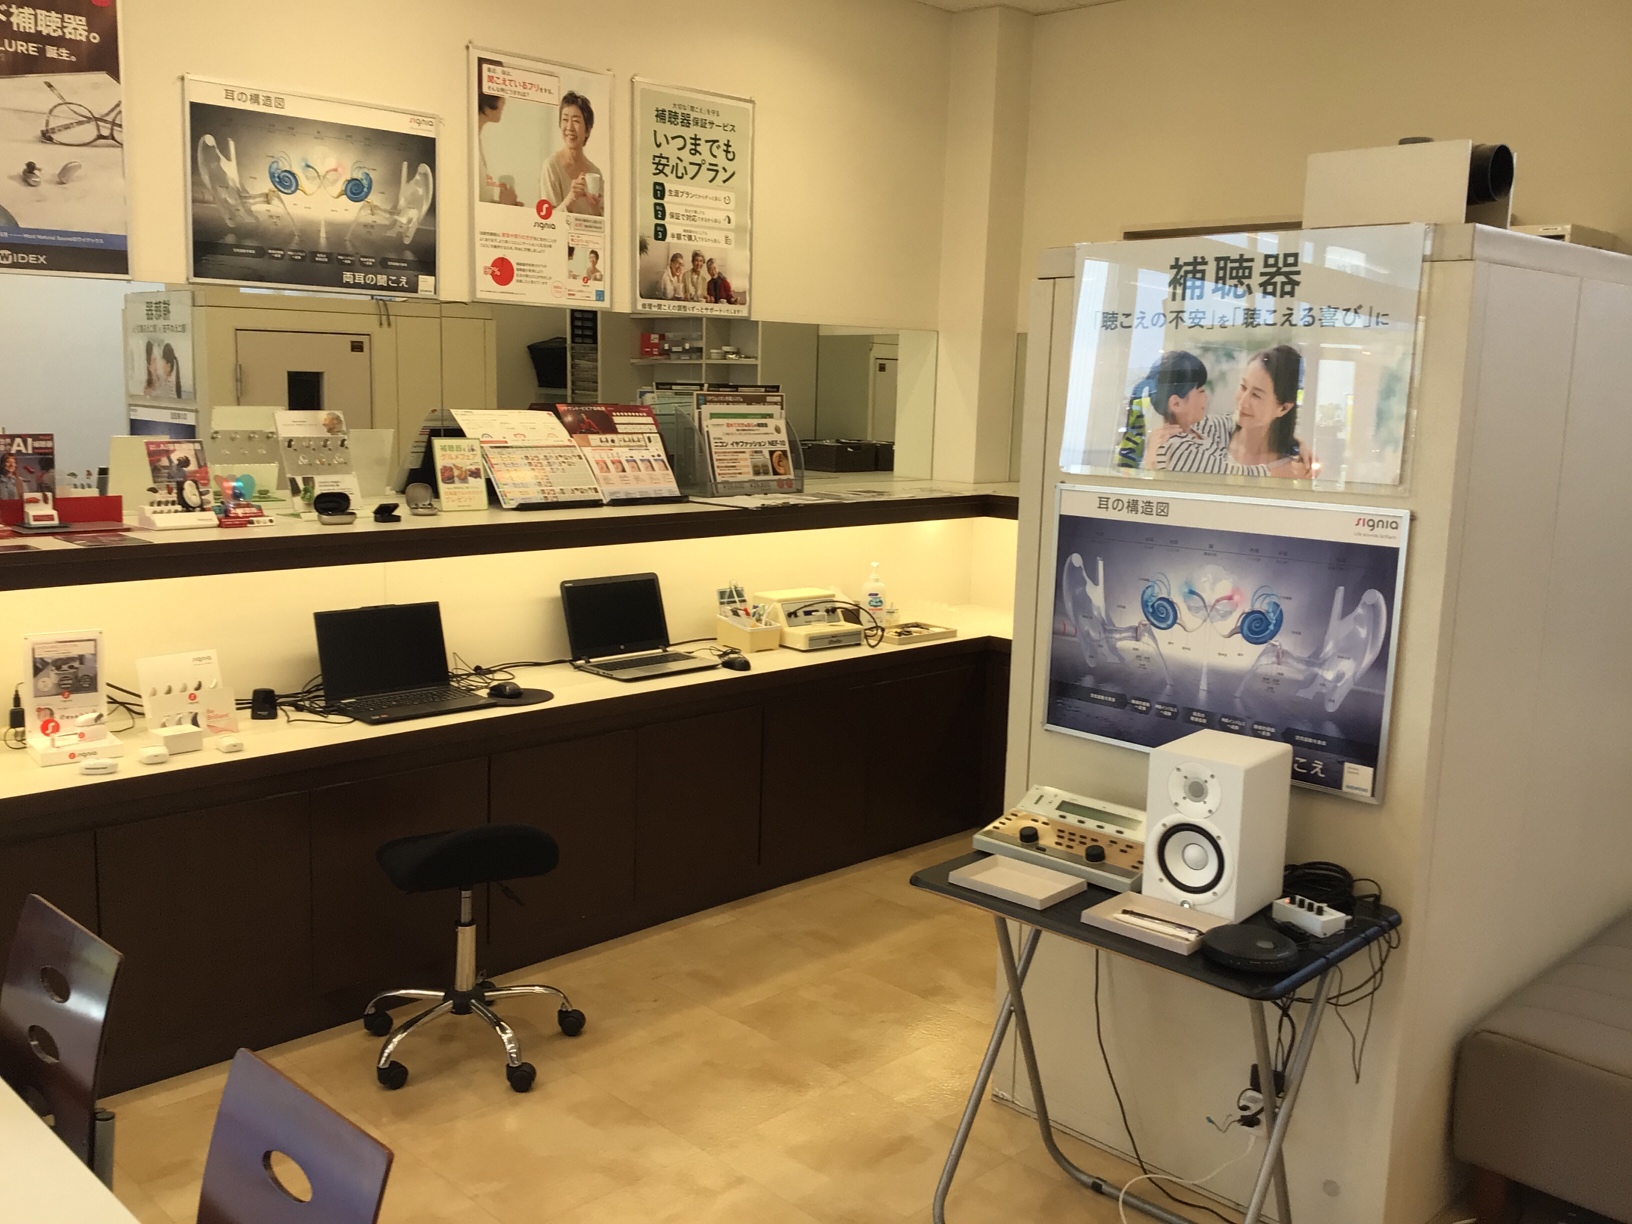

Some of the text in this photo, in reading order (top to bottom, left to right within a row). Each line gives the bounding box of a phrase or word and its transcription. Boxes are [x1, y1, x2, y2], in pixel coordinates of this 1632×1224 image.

[223, 88, 286, 110] 耳の構造図
[653, 129, 736, 162] いつまでも
[651, 153, 736, 184] 安心プラン
[533, 221, 556, 230] signia
[342, 271, 409, 288] 両耳の聞こえ
[1168, 251, 1302, 302] 補聴器
[1094, 303, 1390, 331] 「聴こえの不安」を「聴こえる喜び」に
[10, 437, 33, 454] AI
[1097, 496, 1170, 517] 耳の構造図
[1355, 517, 1399, 531] signia
[1293, 757, 1326, 777] こえ
